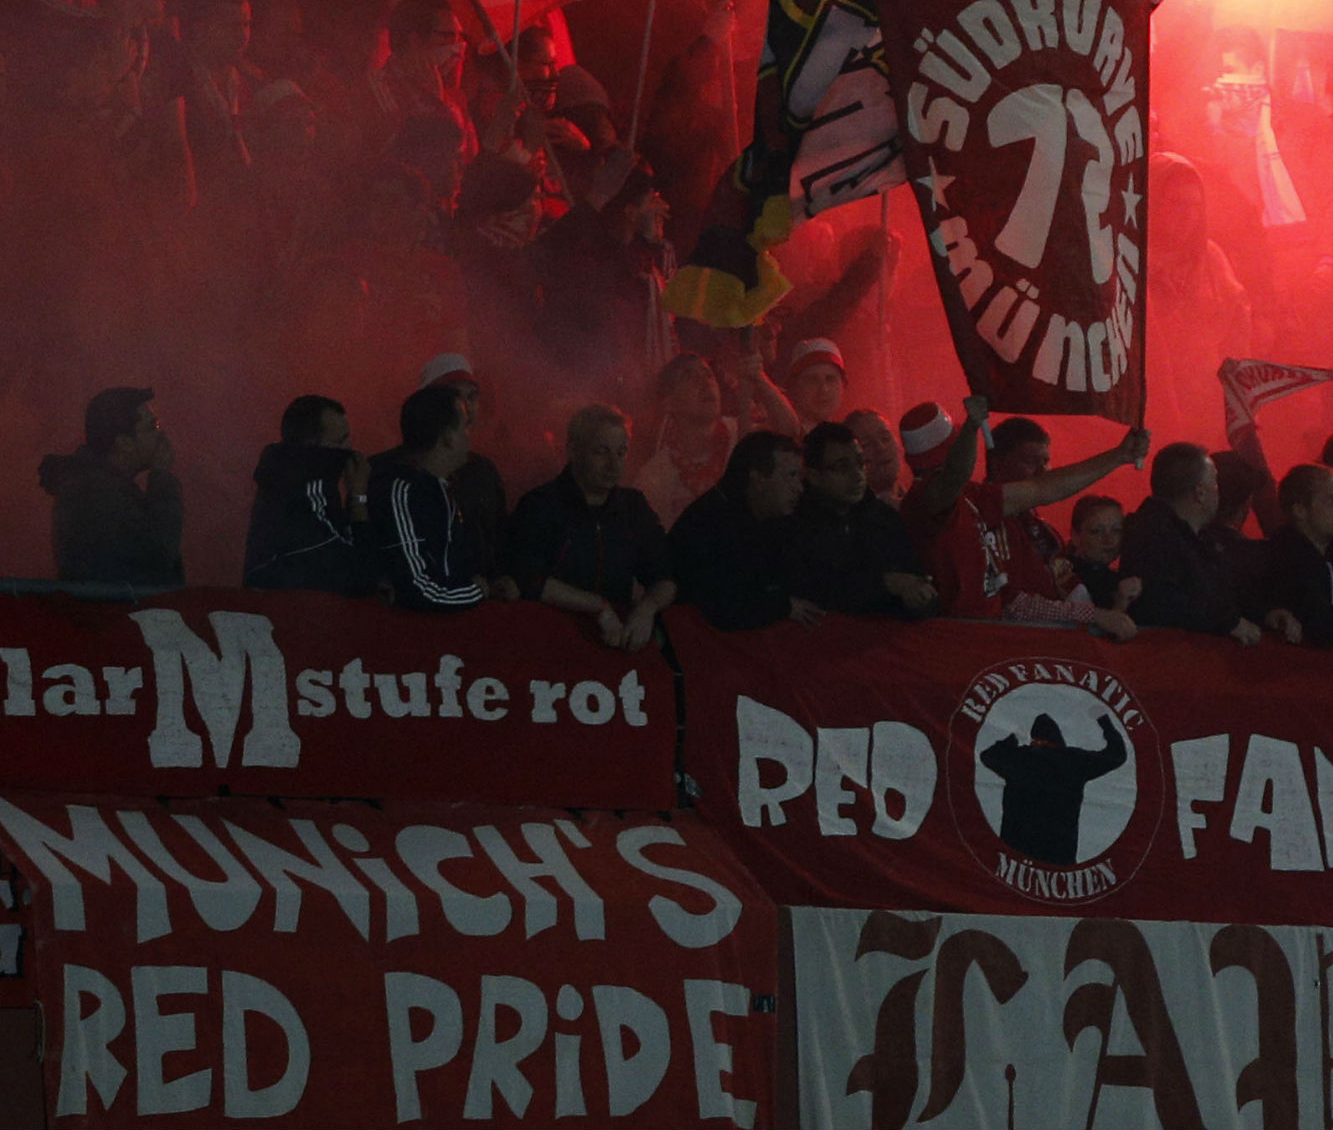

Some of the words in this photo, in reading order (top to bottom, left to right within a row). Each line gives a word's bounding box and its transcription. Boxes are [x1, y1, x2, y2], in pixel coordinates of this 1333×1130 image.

[986, 83, 1115, 286] 72
[529, 668, 649, 727] rot
[960, 671, 1010, 724] RED
[1008, 662, 1145, 732] FANATIC
[737, 695, 939, 839] RED
[994, 851, 1117, 900] MÜNCHEN
[56, 963, 311, 1118] RED
